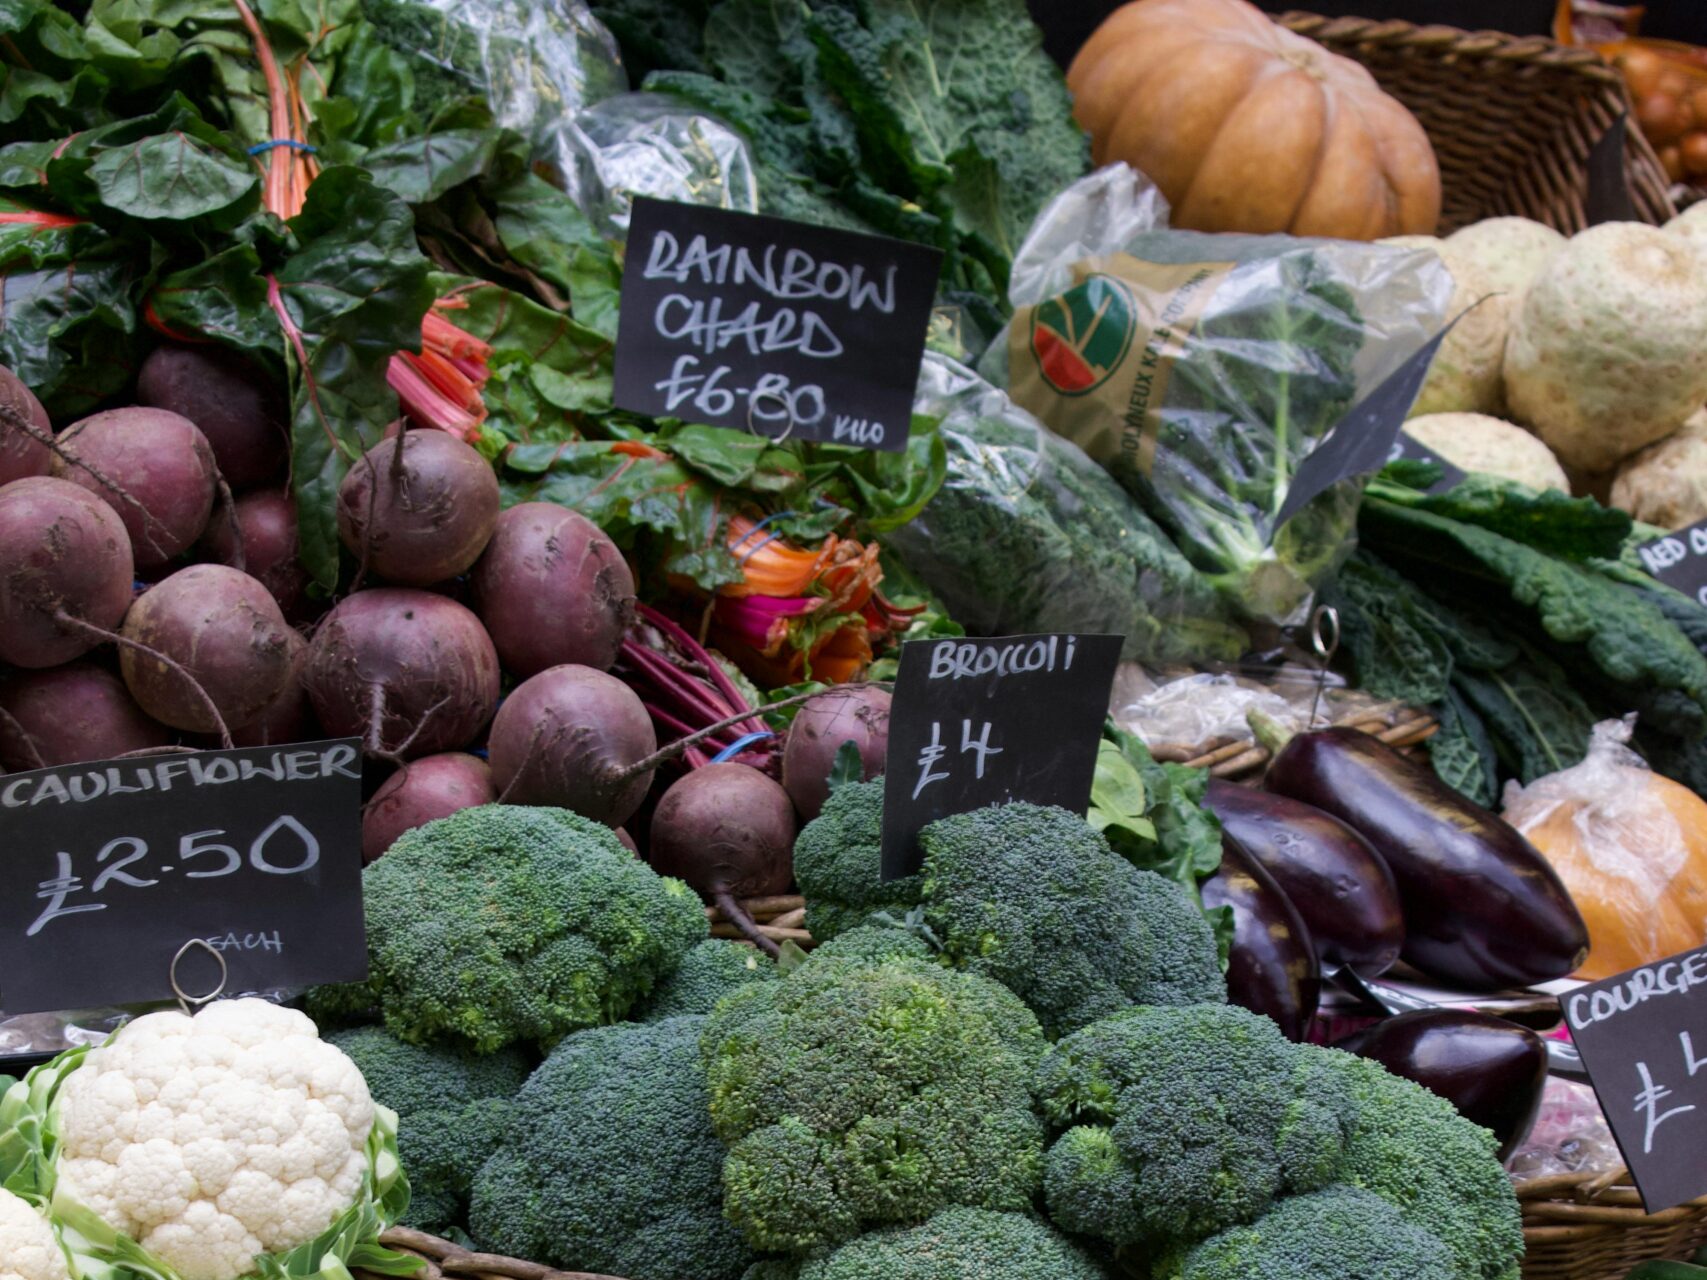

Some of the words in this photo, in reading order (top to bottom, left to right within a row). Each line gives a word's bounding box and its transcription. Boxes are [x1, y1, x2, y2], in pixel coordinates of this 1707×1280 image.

[643, 229, 898, 314] RAINBOW
[654, 293, 843, 357] CHARD
[1639, 537, 1687, 575] RED
[0, 745, 362, 808] CAULIFLOWER
[207, 930, 284, 953] EACH
[1569, 952, 1707, 1030] COURGE
